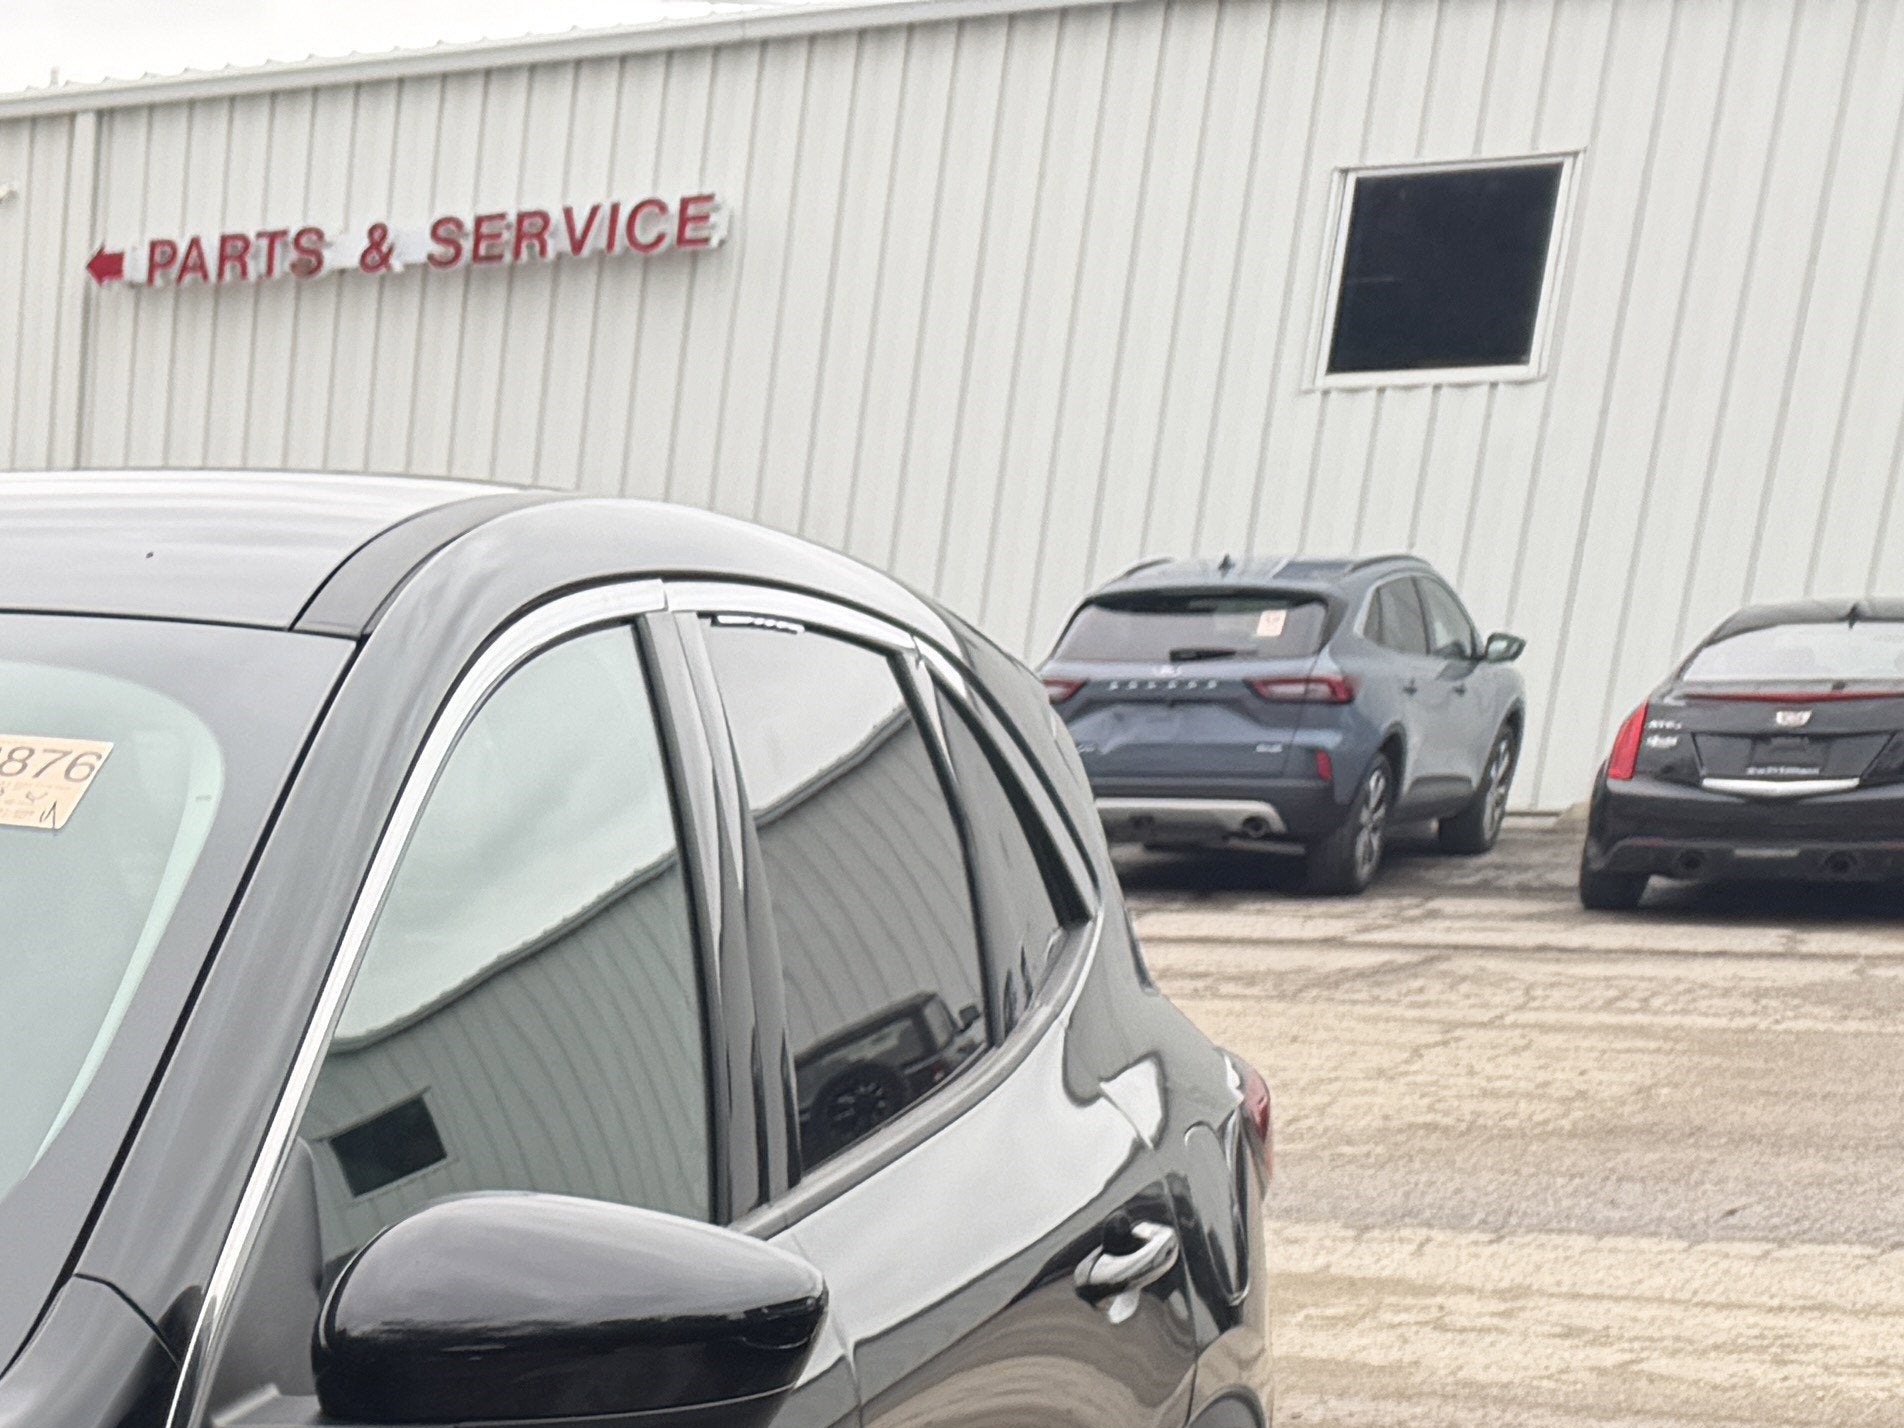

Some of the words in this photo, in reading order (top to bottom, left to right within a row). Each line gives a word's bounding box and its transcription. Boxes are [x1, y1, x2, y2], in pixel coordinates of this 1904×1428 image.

[146, 228, 325, 285] PARTS
[359, 221, 394, 273] &
[427, 193, 715, 268] SERVICE
